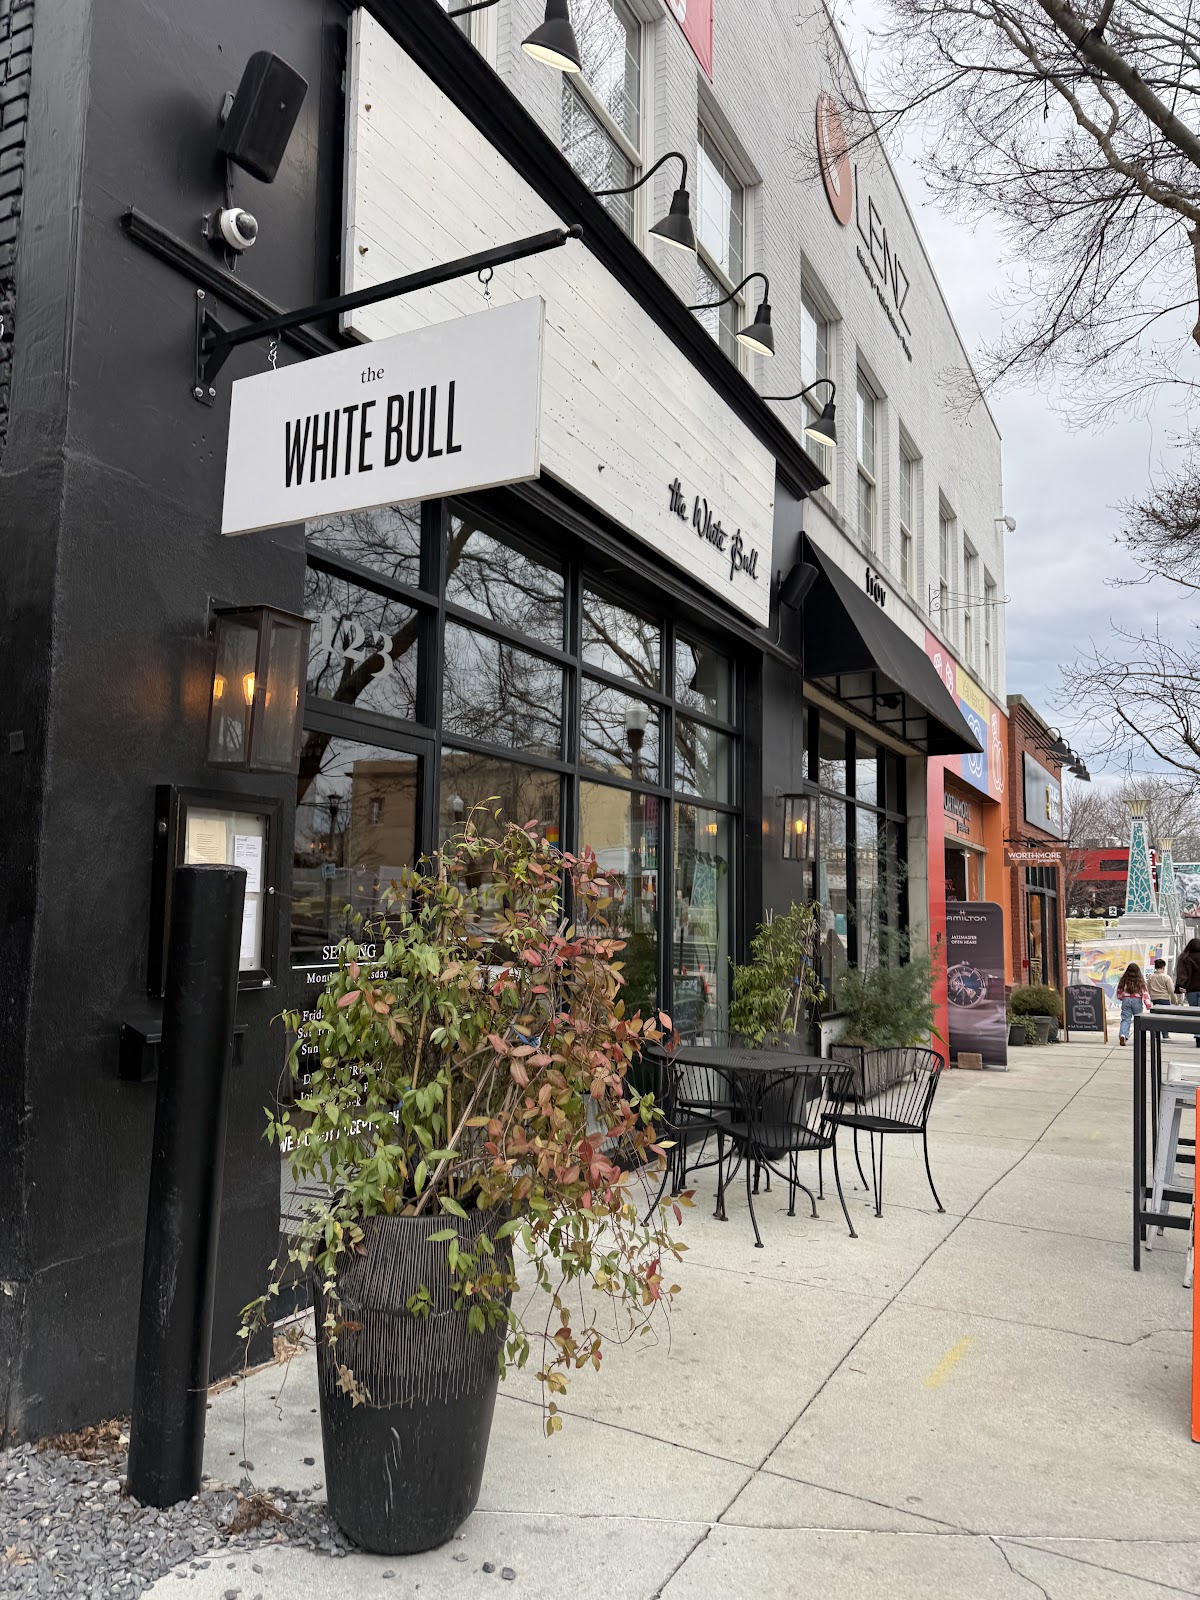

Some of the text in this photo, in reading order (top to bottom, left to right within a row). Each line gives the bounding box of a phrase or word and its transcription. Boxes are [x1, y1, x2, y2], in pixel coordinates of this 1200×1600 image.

[854, 164, 911, 336] LENZ
[360, 366, 385, 384] the
[285, 380, 462, 488] WHITE BULL
[668, 477, 759, 581] the White Bull
[319, 612, 394, 680] 123
[1008, 851, 1062, 859] WORTHMORE
